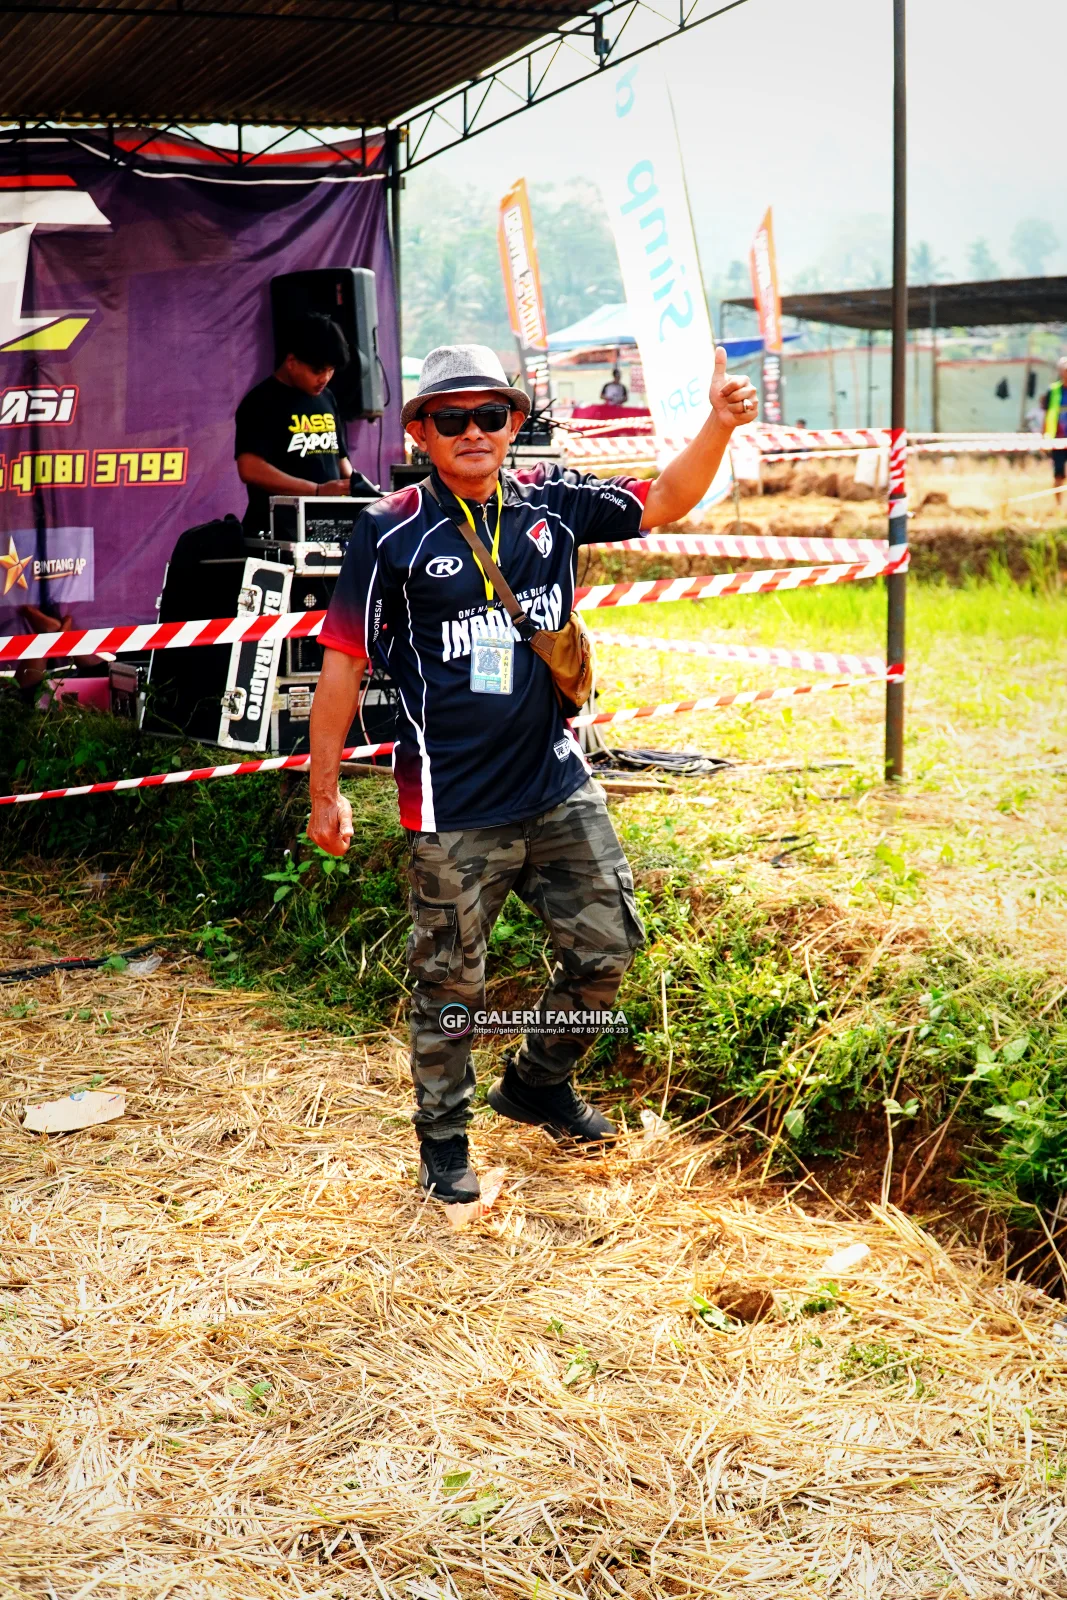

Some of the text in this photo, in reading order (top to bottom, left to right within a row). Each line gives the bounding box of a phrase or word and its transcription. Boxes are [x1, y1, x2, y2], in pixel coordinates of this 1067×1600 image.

[288, 413, 336, 433] JASS
[13, 453, 85, 492] 4081
[95, 452, 184, 483] 3799
[33, 559, 74, 574] BINTANG
[458, 607, 476, 620] ONE
[513, 592, 529, 602] NE
